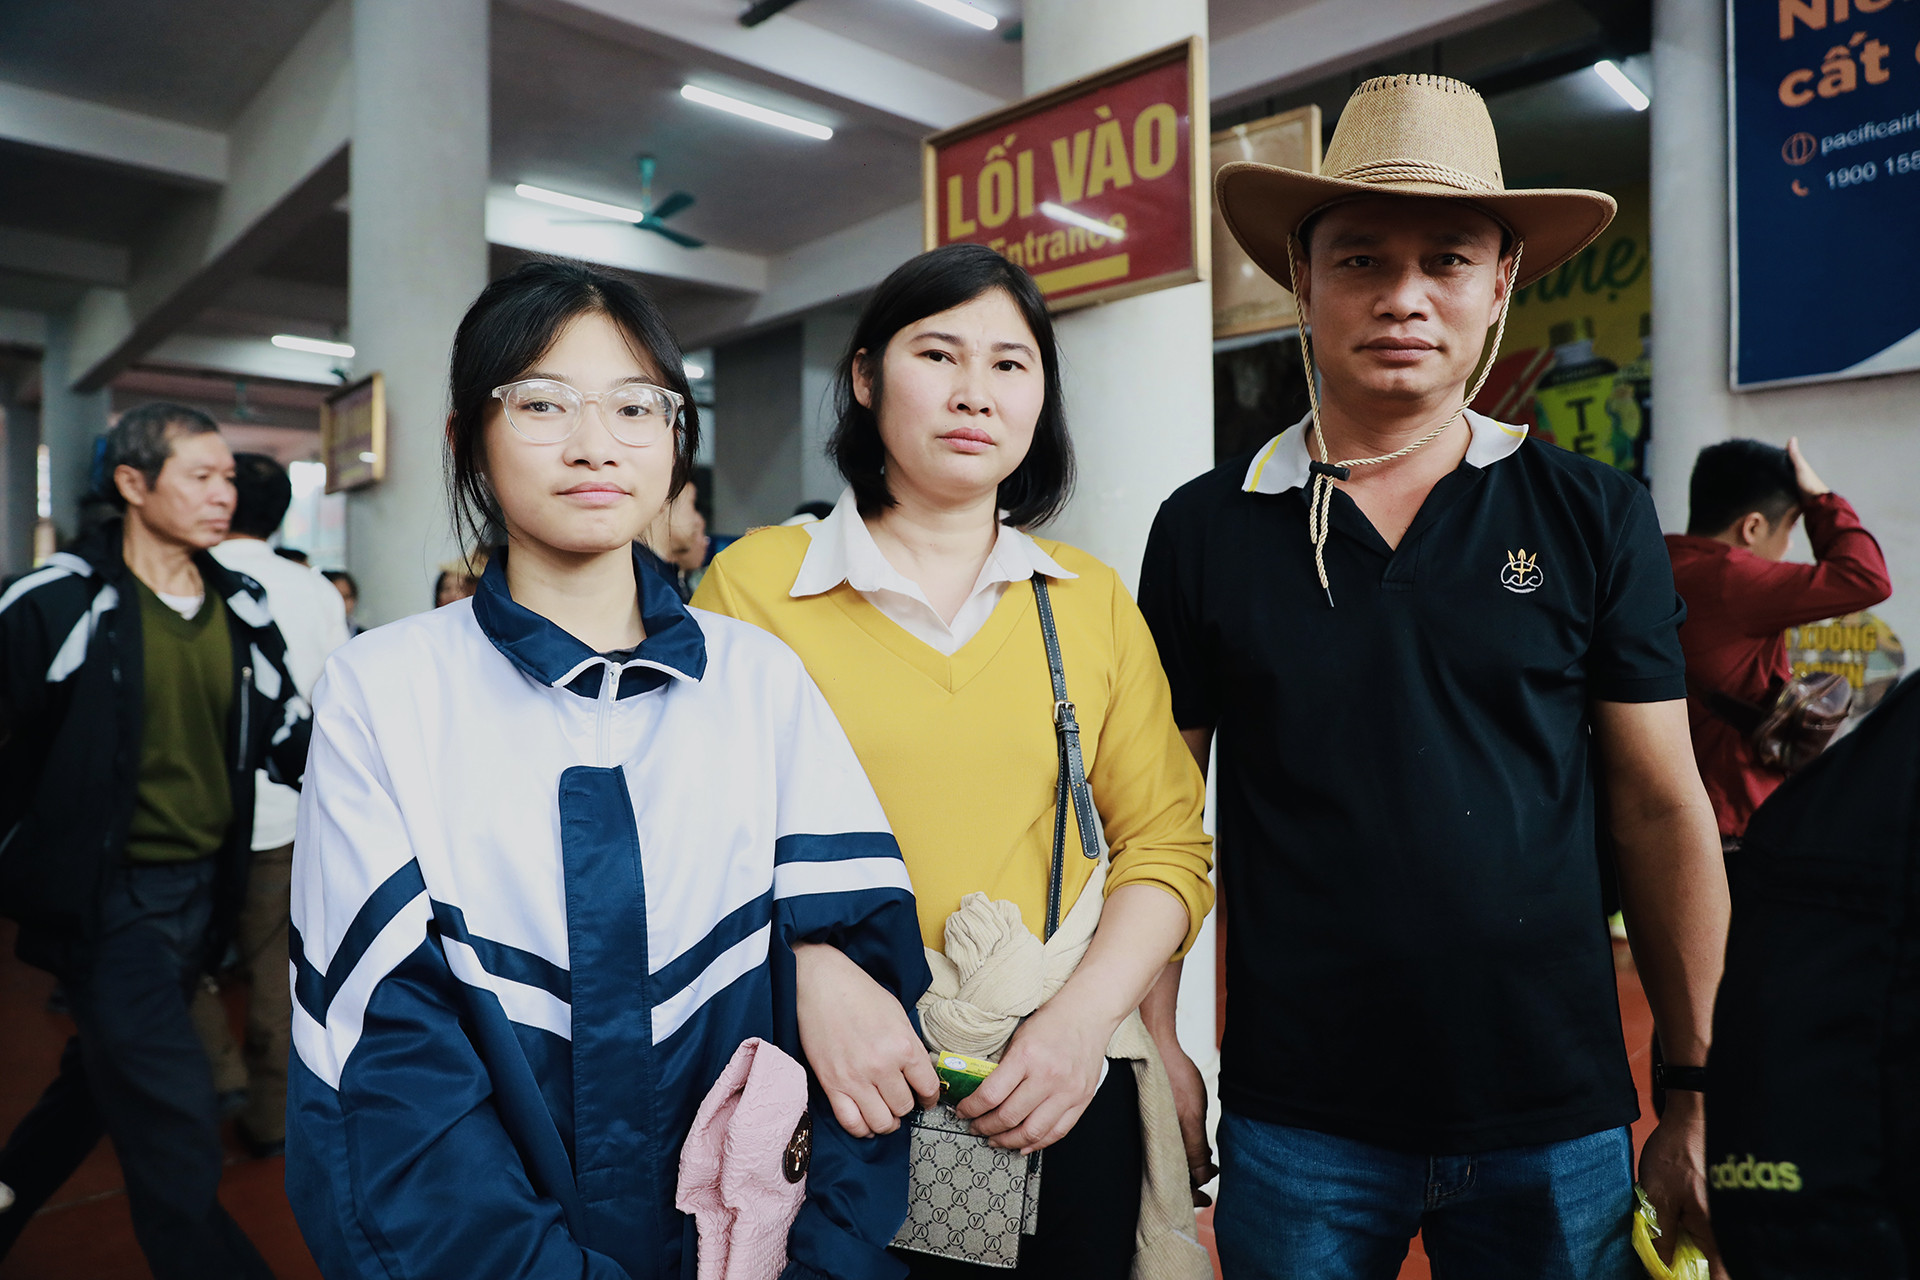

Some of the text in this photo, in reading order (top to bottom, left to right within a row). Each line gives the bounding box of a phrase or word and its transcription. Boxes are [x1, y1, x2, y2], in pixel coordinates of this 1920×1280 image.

[1779, 0, 1893, 41] Ni
[1778, 31, 1890, 108] cất
[947, 103, 1178, 240] LỐI VÀO
[1825, 161, 1877, 189] 1900
